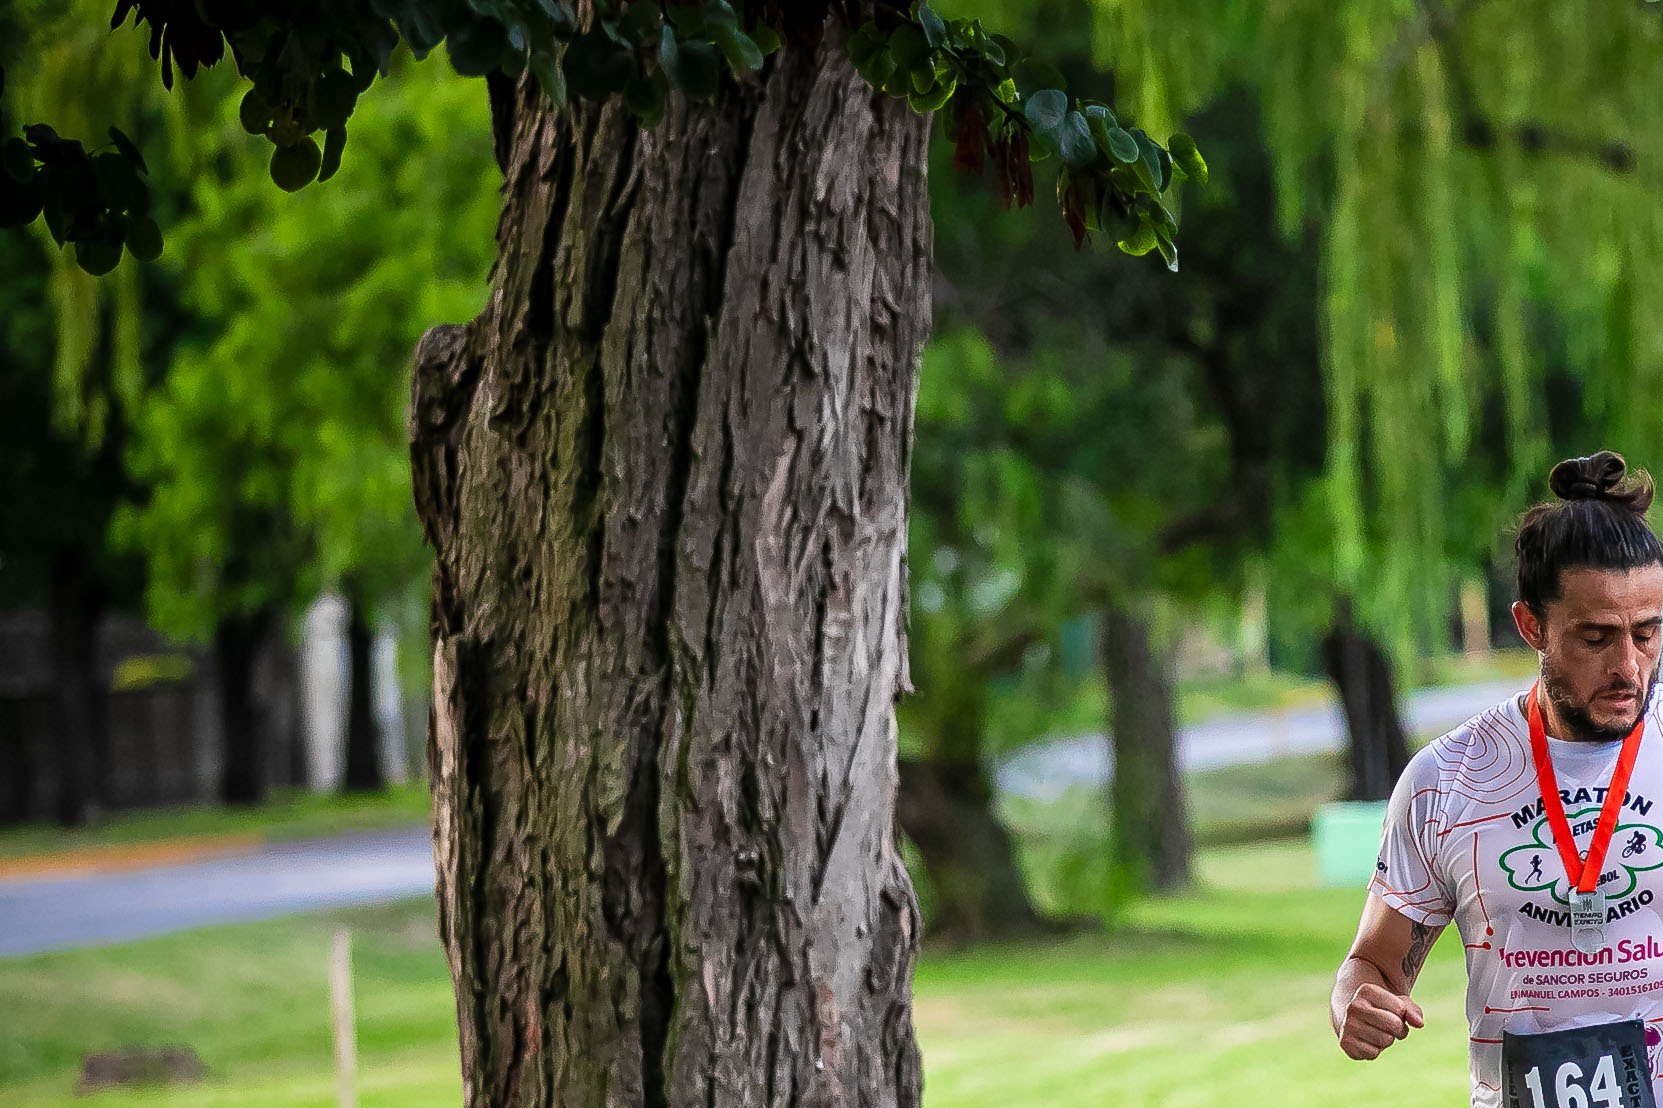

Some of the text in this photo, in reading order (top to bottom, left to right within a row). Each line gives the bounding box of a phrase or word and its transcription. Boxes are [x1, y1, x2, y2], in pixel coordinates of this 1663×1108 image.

[1518, 889, 1654, 928] ANIVARIO
[1523, 968, 1648, 986] de SANCOR SEGUROS
[1557, 988, 1600, 999] CAMPOS
